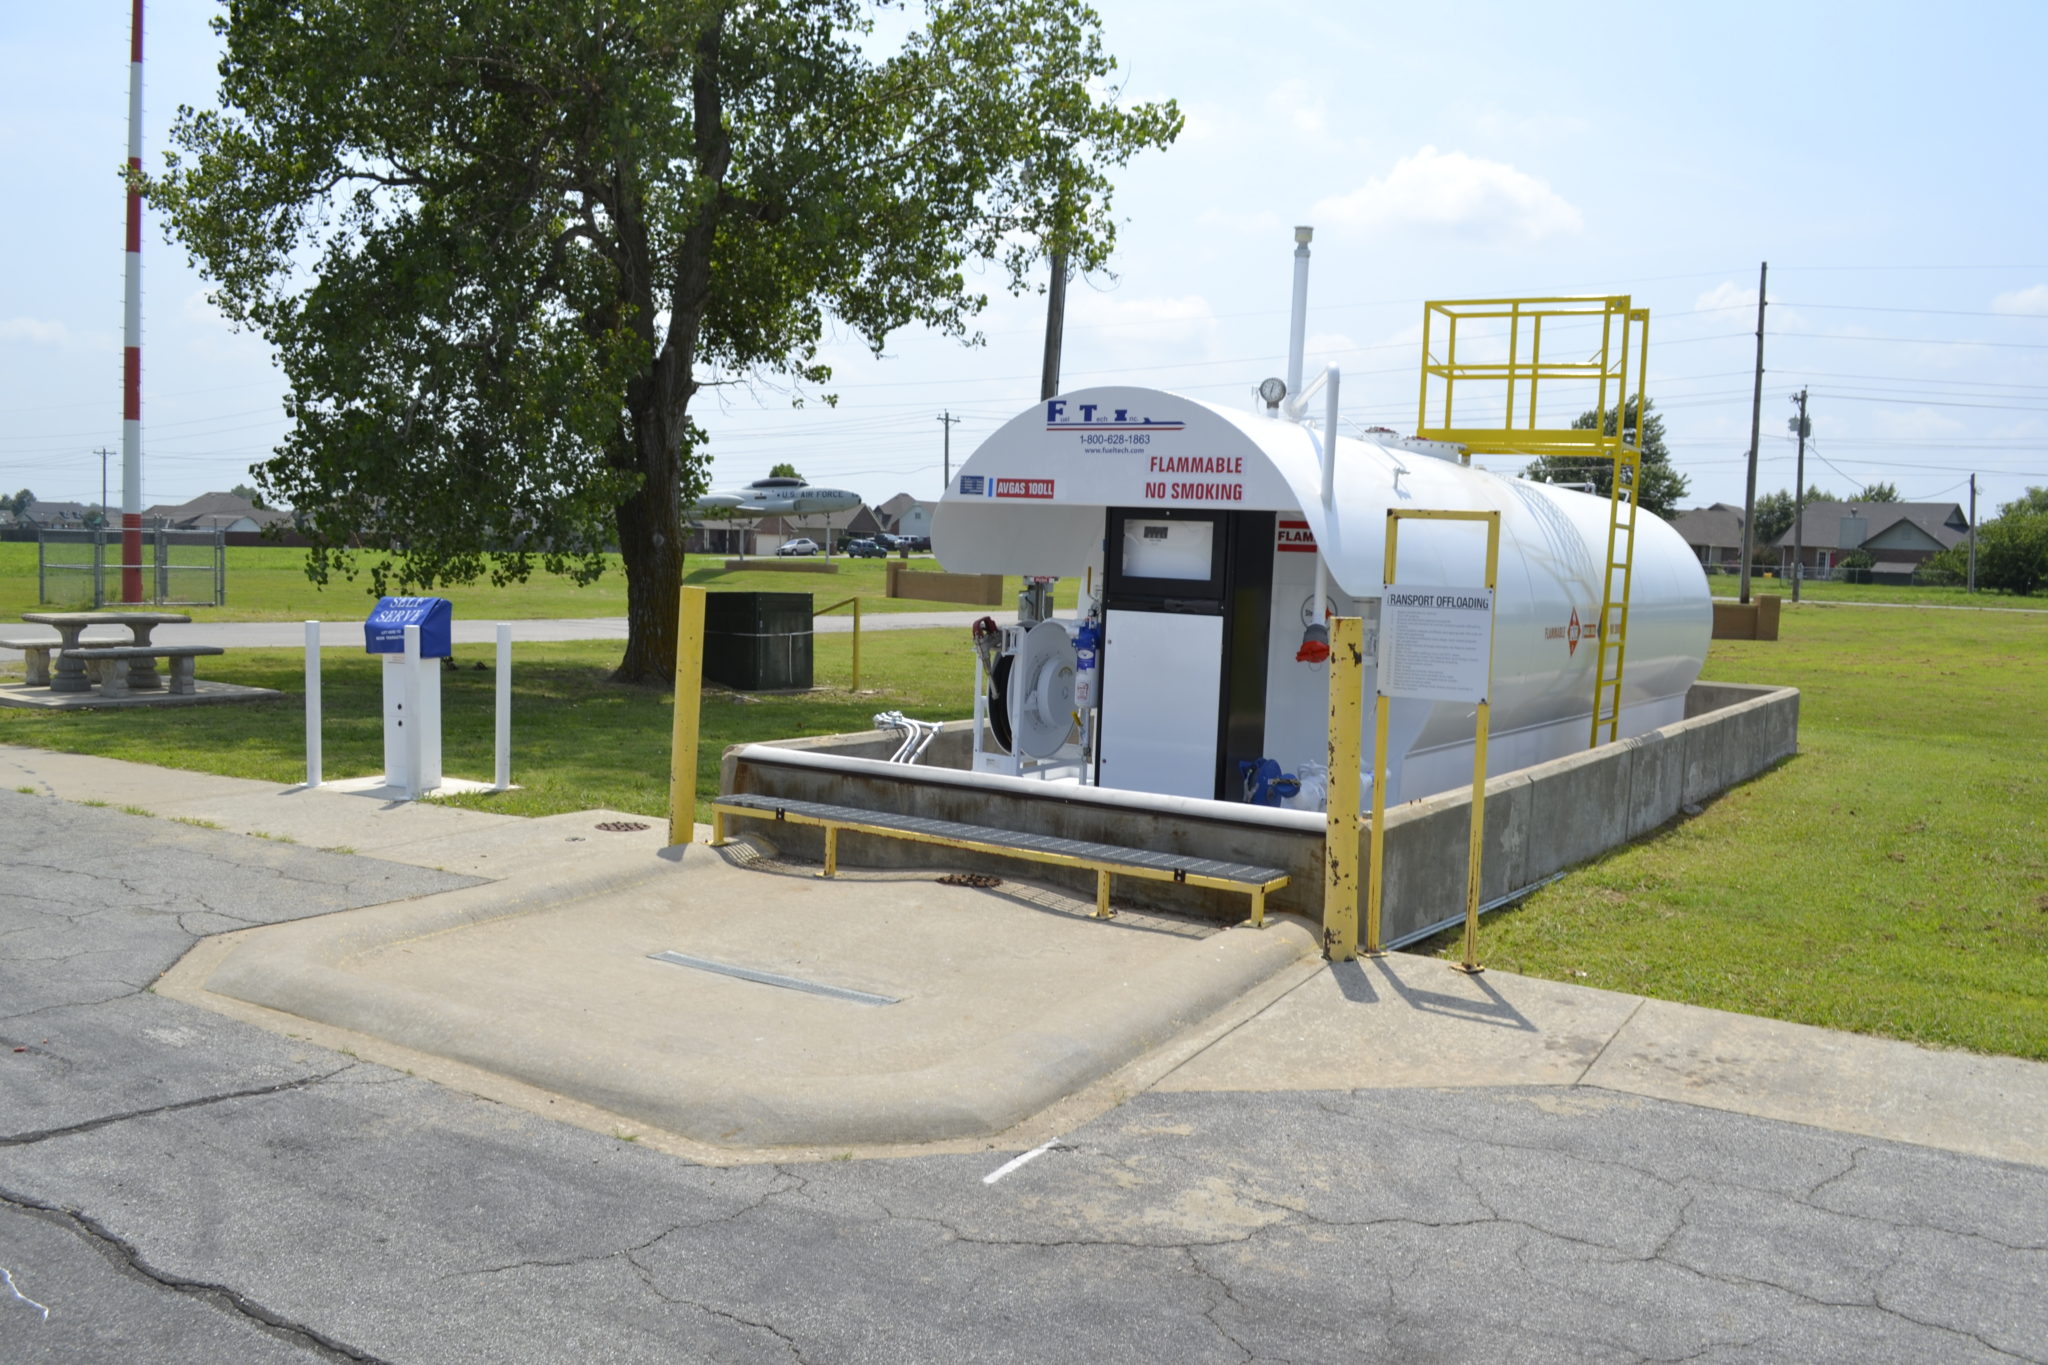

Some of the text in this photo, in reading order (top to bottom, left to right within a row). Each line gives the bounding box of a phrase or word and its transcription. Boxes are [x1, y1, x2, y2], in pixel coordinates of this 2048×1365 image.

[1080, 434, 1150, 445] 1-800-628-1863
[1150, 456, 1243, 473] FLAMMABLE
[997, 481, 1025, 495] AVGAS
[1028, 482, 1053, 495] 100LL
[1145, 482, 1243, 500] NO SMOKING
[1277, 531, 1316, 543] FLAM
[1436, 596, 1489, 609] OFFLOADING
[375, 609, 424, 622] SERVE
